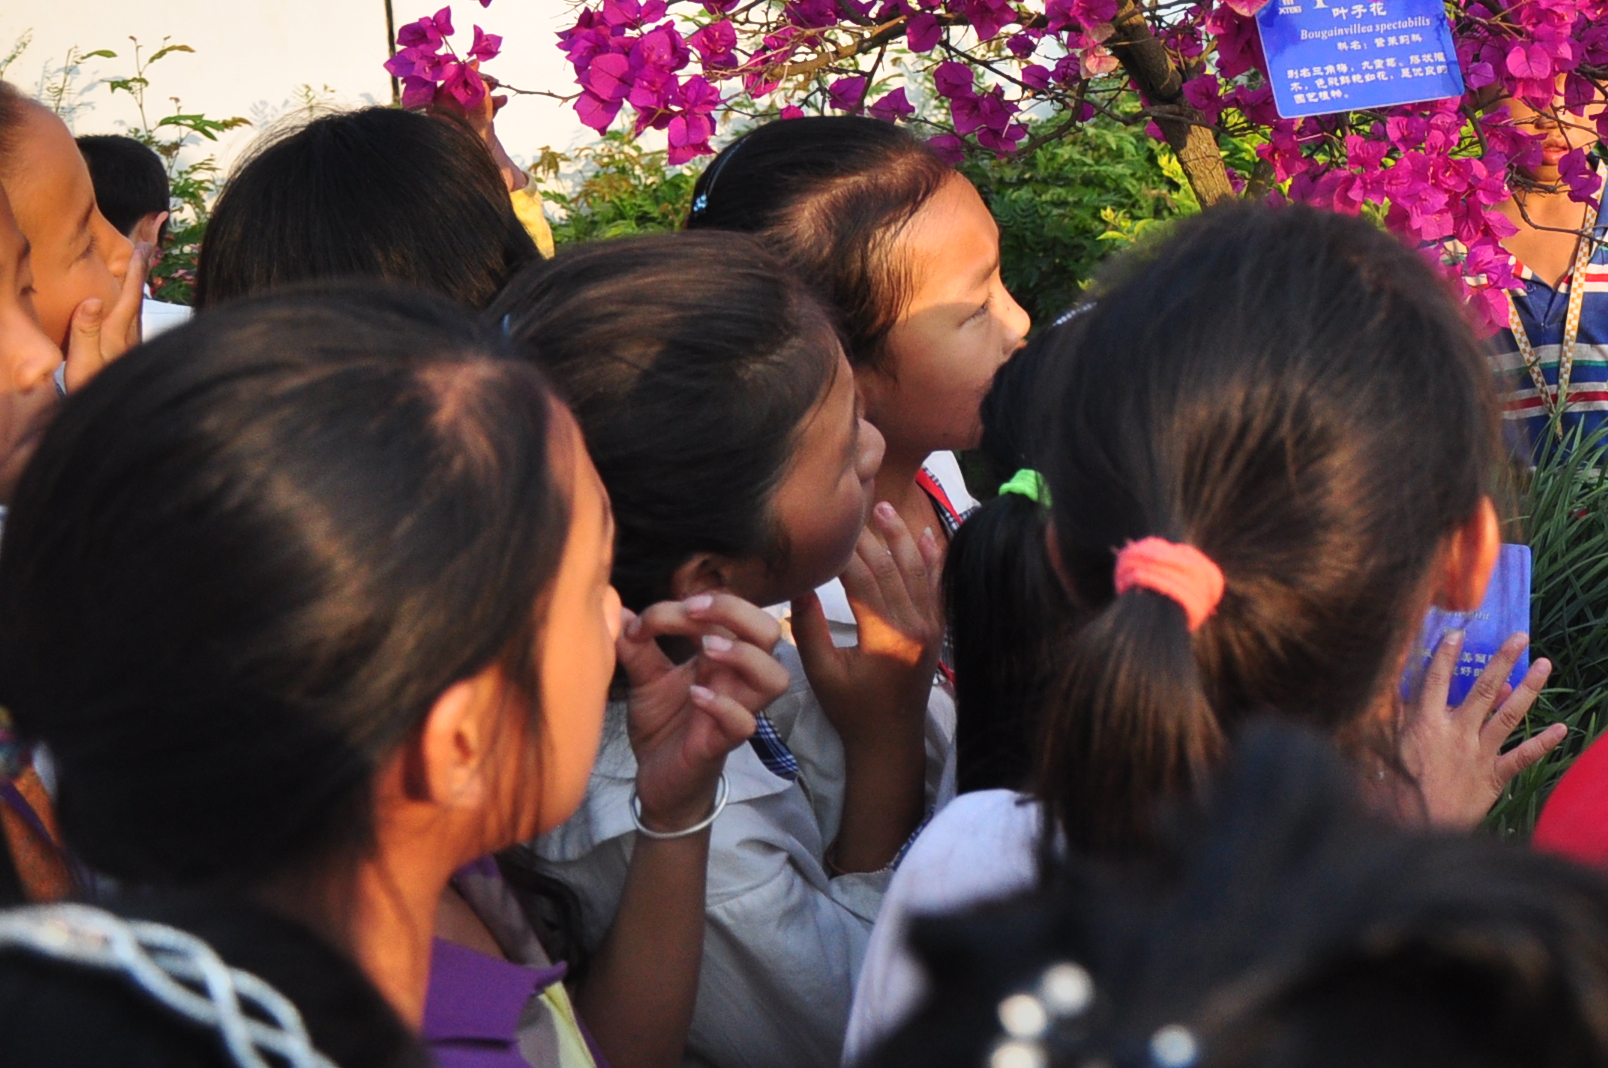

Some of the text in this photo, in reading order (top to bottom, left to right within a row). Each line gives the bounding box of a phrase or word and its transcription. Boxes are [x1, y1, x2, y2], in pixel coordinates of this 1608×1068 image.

[1332, 2, 1387, 20] 叶子花
[1301, 15, 1430, 40] Bougainvillea spectabilis
